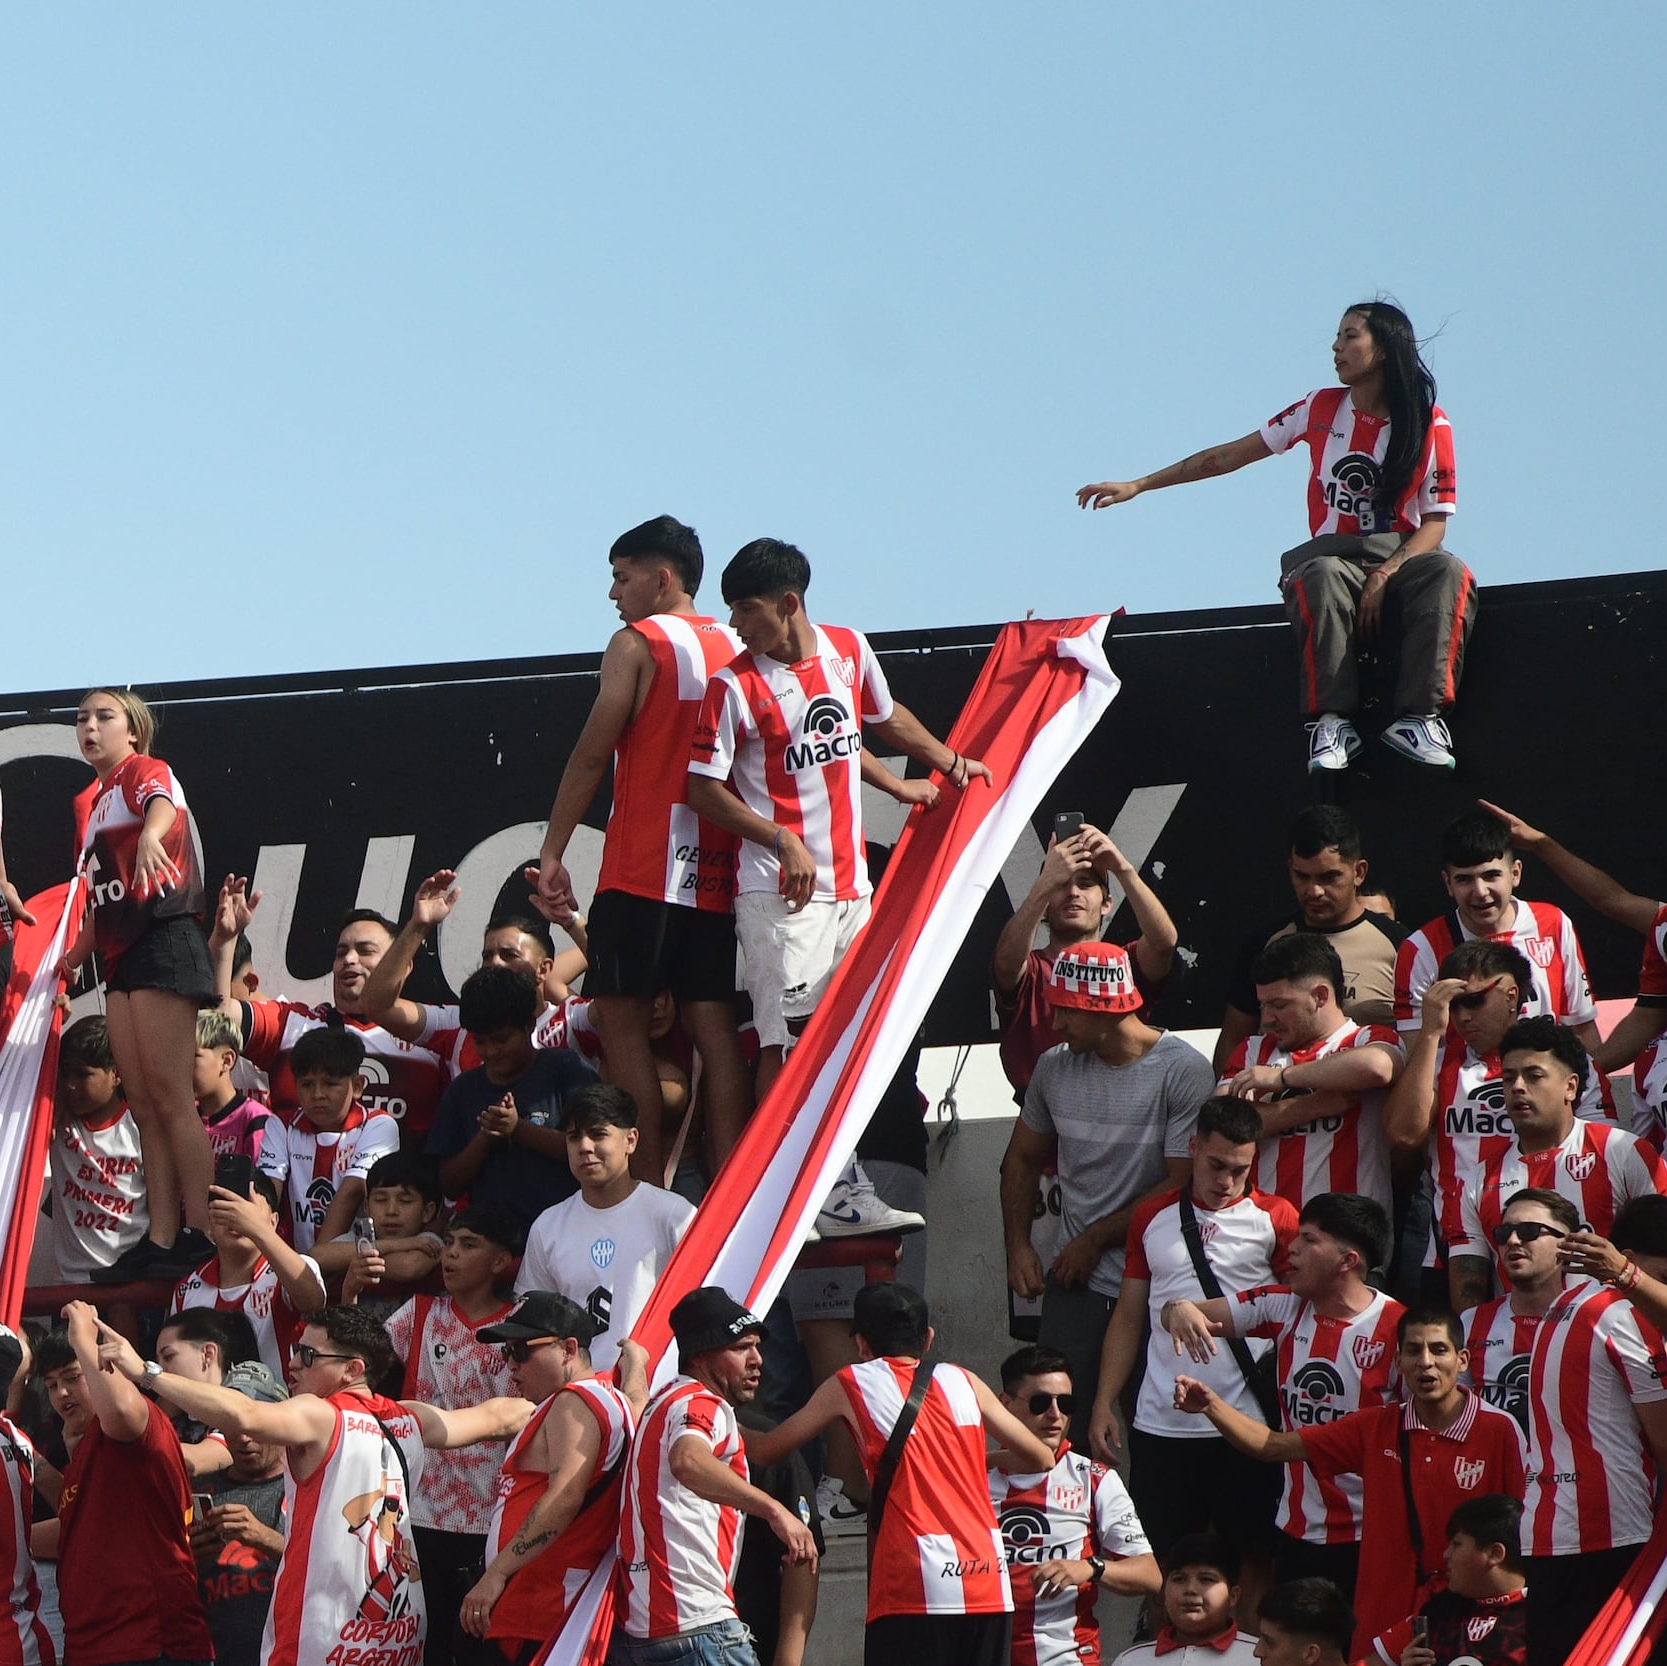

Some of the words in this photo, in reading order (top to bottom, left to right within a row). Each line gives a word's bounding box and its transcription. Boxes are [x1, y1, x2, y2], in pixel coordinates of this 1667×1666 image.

[785, 733, 862, 774] Macro
[1054, 960, 1125, 983] INSTITUTO
[1446, 1106, 1518, 1136] Mac
[62, 1183, 135, 1215] PRIMERA
[73, 1210, 120, 1232] 2022
[813, 1301, 851, 1309] KELME
[940, 1559, 992, 1579] RUTA
[204, 1574, 273, 1604] Mac
